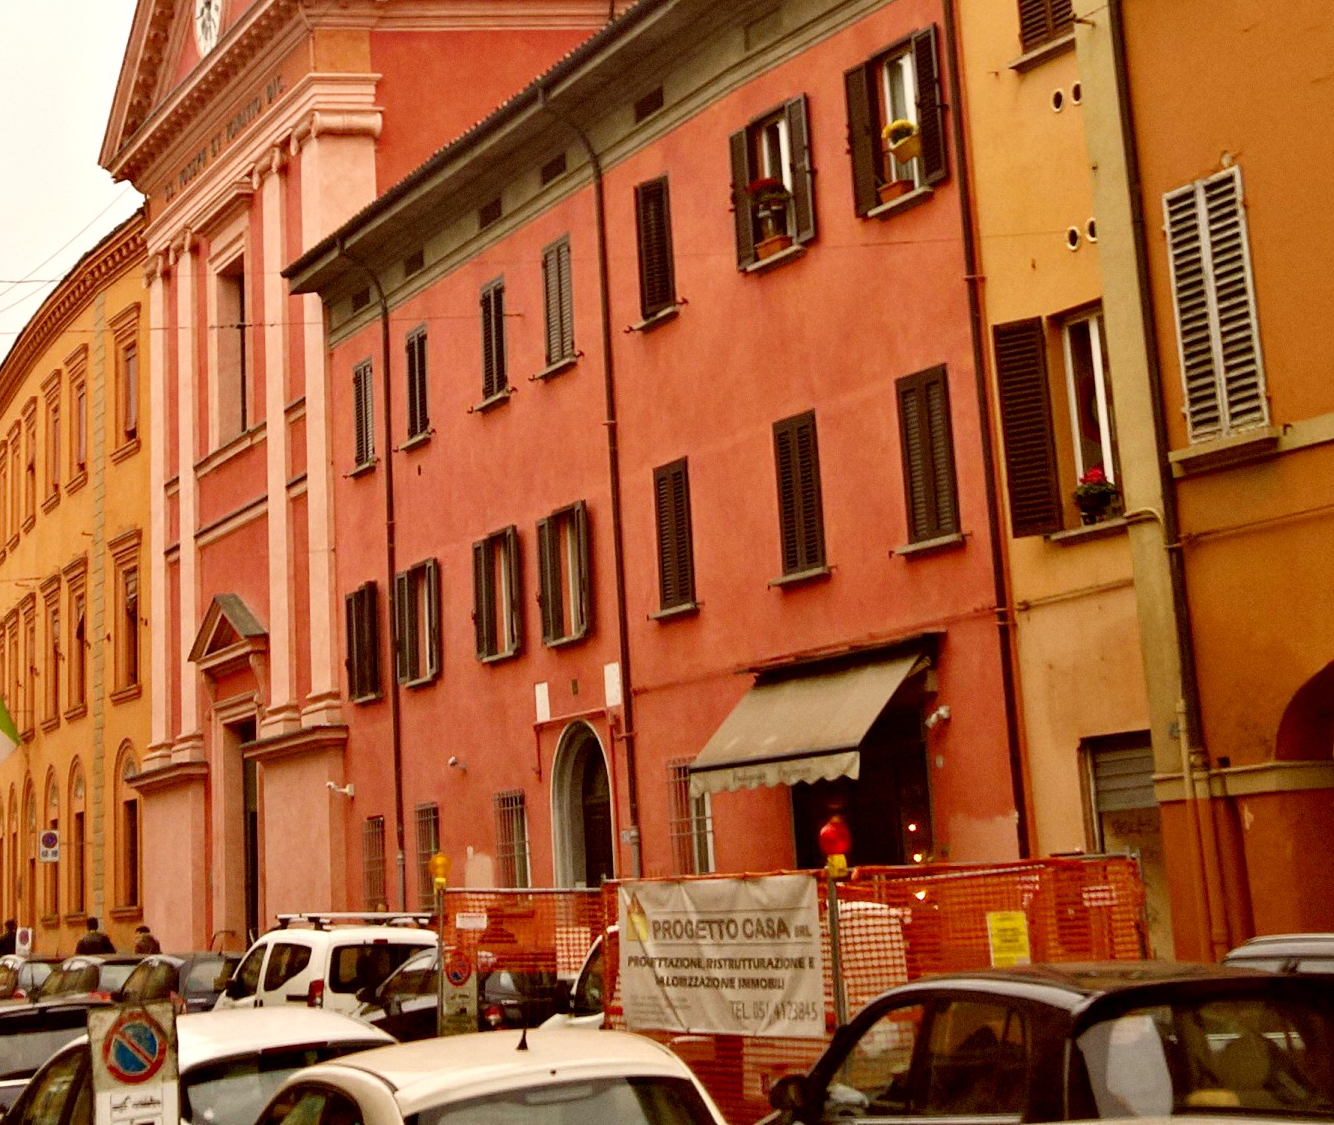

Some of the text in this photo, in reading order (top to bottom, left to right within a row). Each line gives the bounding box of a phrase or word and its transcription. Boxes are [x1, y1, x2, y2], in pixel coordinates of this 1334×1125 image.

[652, 918, 739, 940] PROGETTO
[743, 917, 791, 939] CASA
[707, 956, 805, 970] RISTRUTTURAZIONE
[808, 957, 815, 969] E
[738, 977, 785, 990] IMMOBILI
